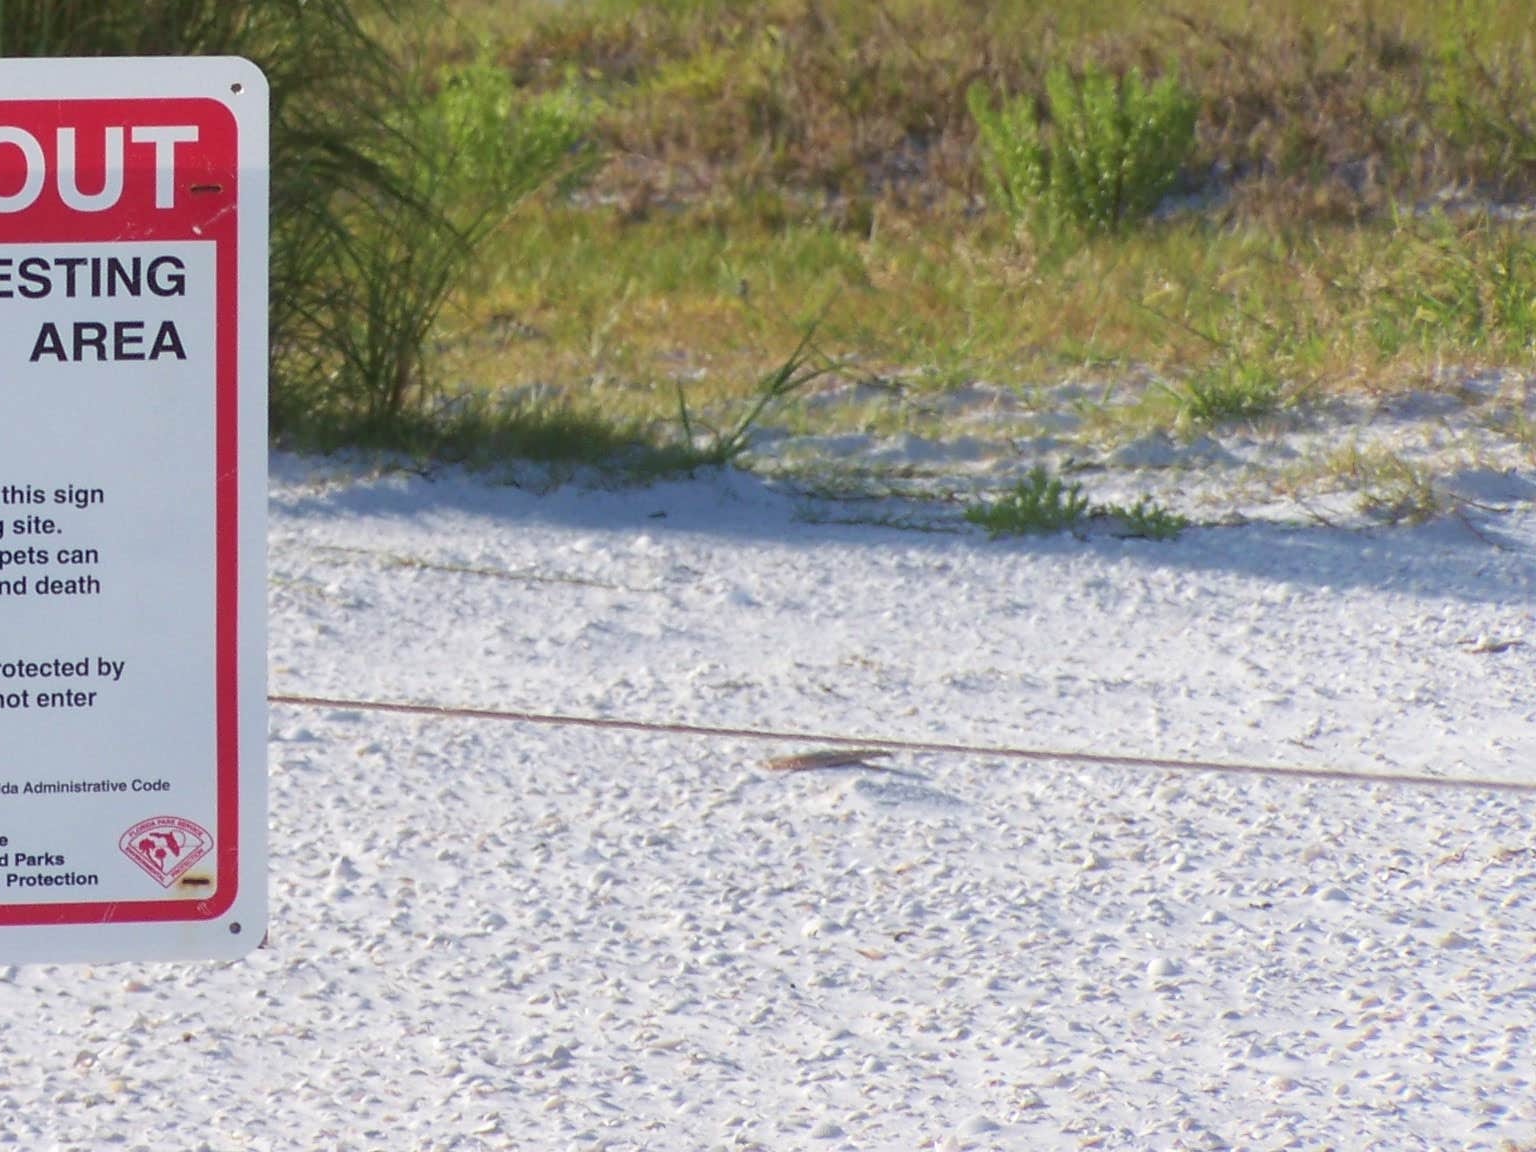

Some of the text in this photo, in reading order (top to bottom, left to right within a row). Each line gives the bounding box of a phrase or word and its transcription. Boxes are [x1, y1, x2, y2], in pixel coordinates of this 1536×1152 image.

[30, 321, 186, 362] AREA
[2, 485, 45, 504] this
[54, 484, 104, 509] sign
[13, 515, 62, 534] site.
[0, 547, 49, 570] pets
[57, 549, 98, 564] can
[35, 575, 100, 595] death
[98, 657, 125, 681] by
[37, 689, 97, 707] enter
[23, 780, 127, 794] Administrative
[131, 779, 170, 792] Code
[15, 852, 65, 866] Parks
[7, 872, 98, 887] Protection
